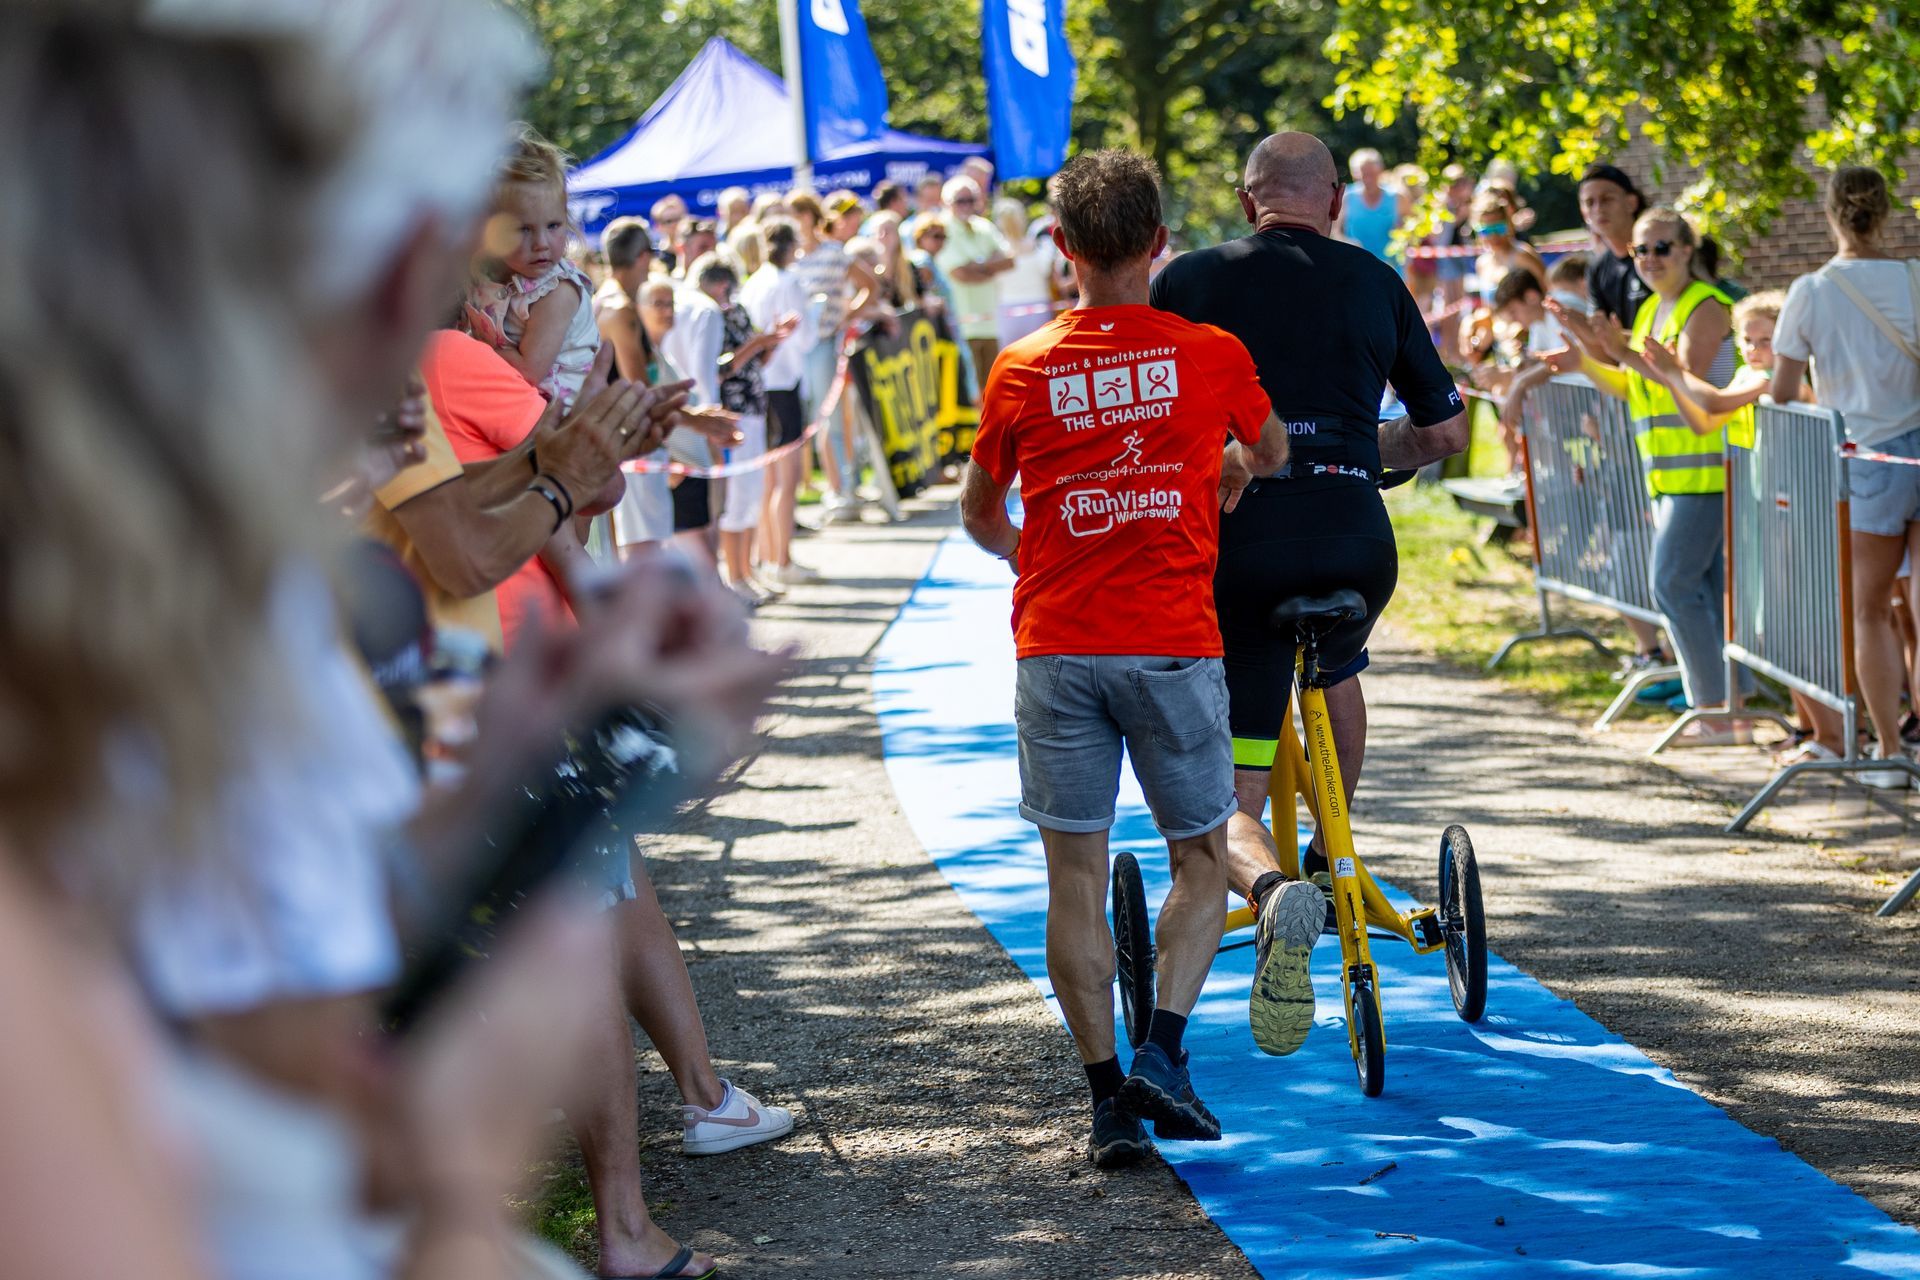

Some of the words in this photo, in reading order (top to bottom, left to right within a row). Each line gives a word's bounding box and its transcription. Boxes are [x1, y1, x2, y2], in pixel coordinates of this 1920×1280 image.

[1083, 358, 1092, 369] &
[1097, 346, 1177, 366] healthcenter
[1062, 414, 1096, 433] THE
[1101, 401, 1173, 426] CHARIOT
[1077, 487, 1183, 517] RunVision
[1316, 723, 1341, 818] www.theAlinker.com
